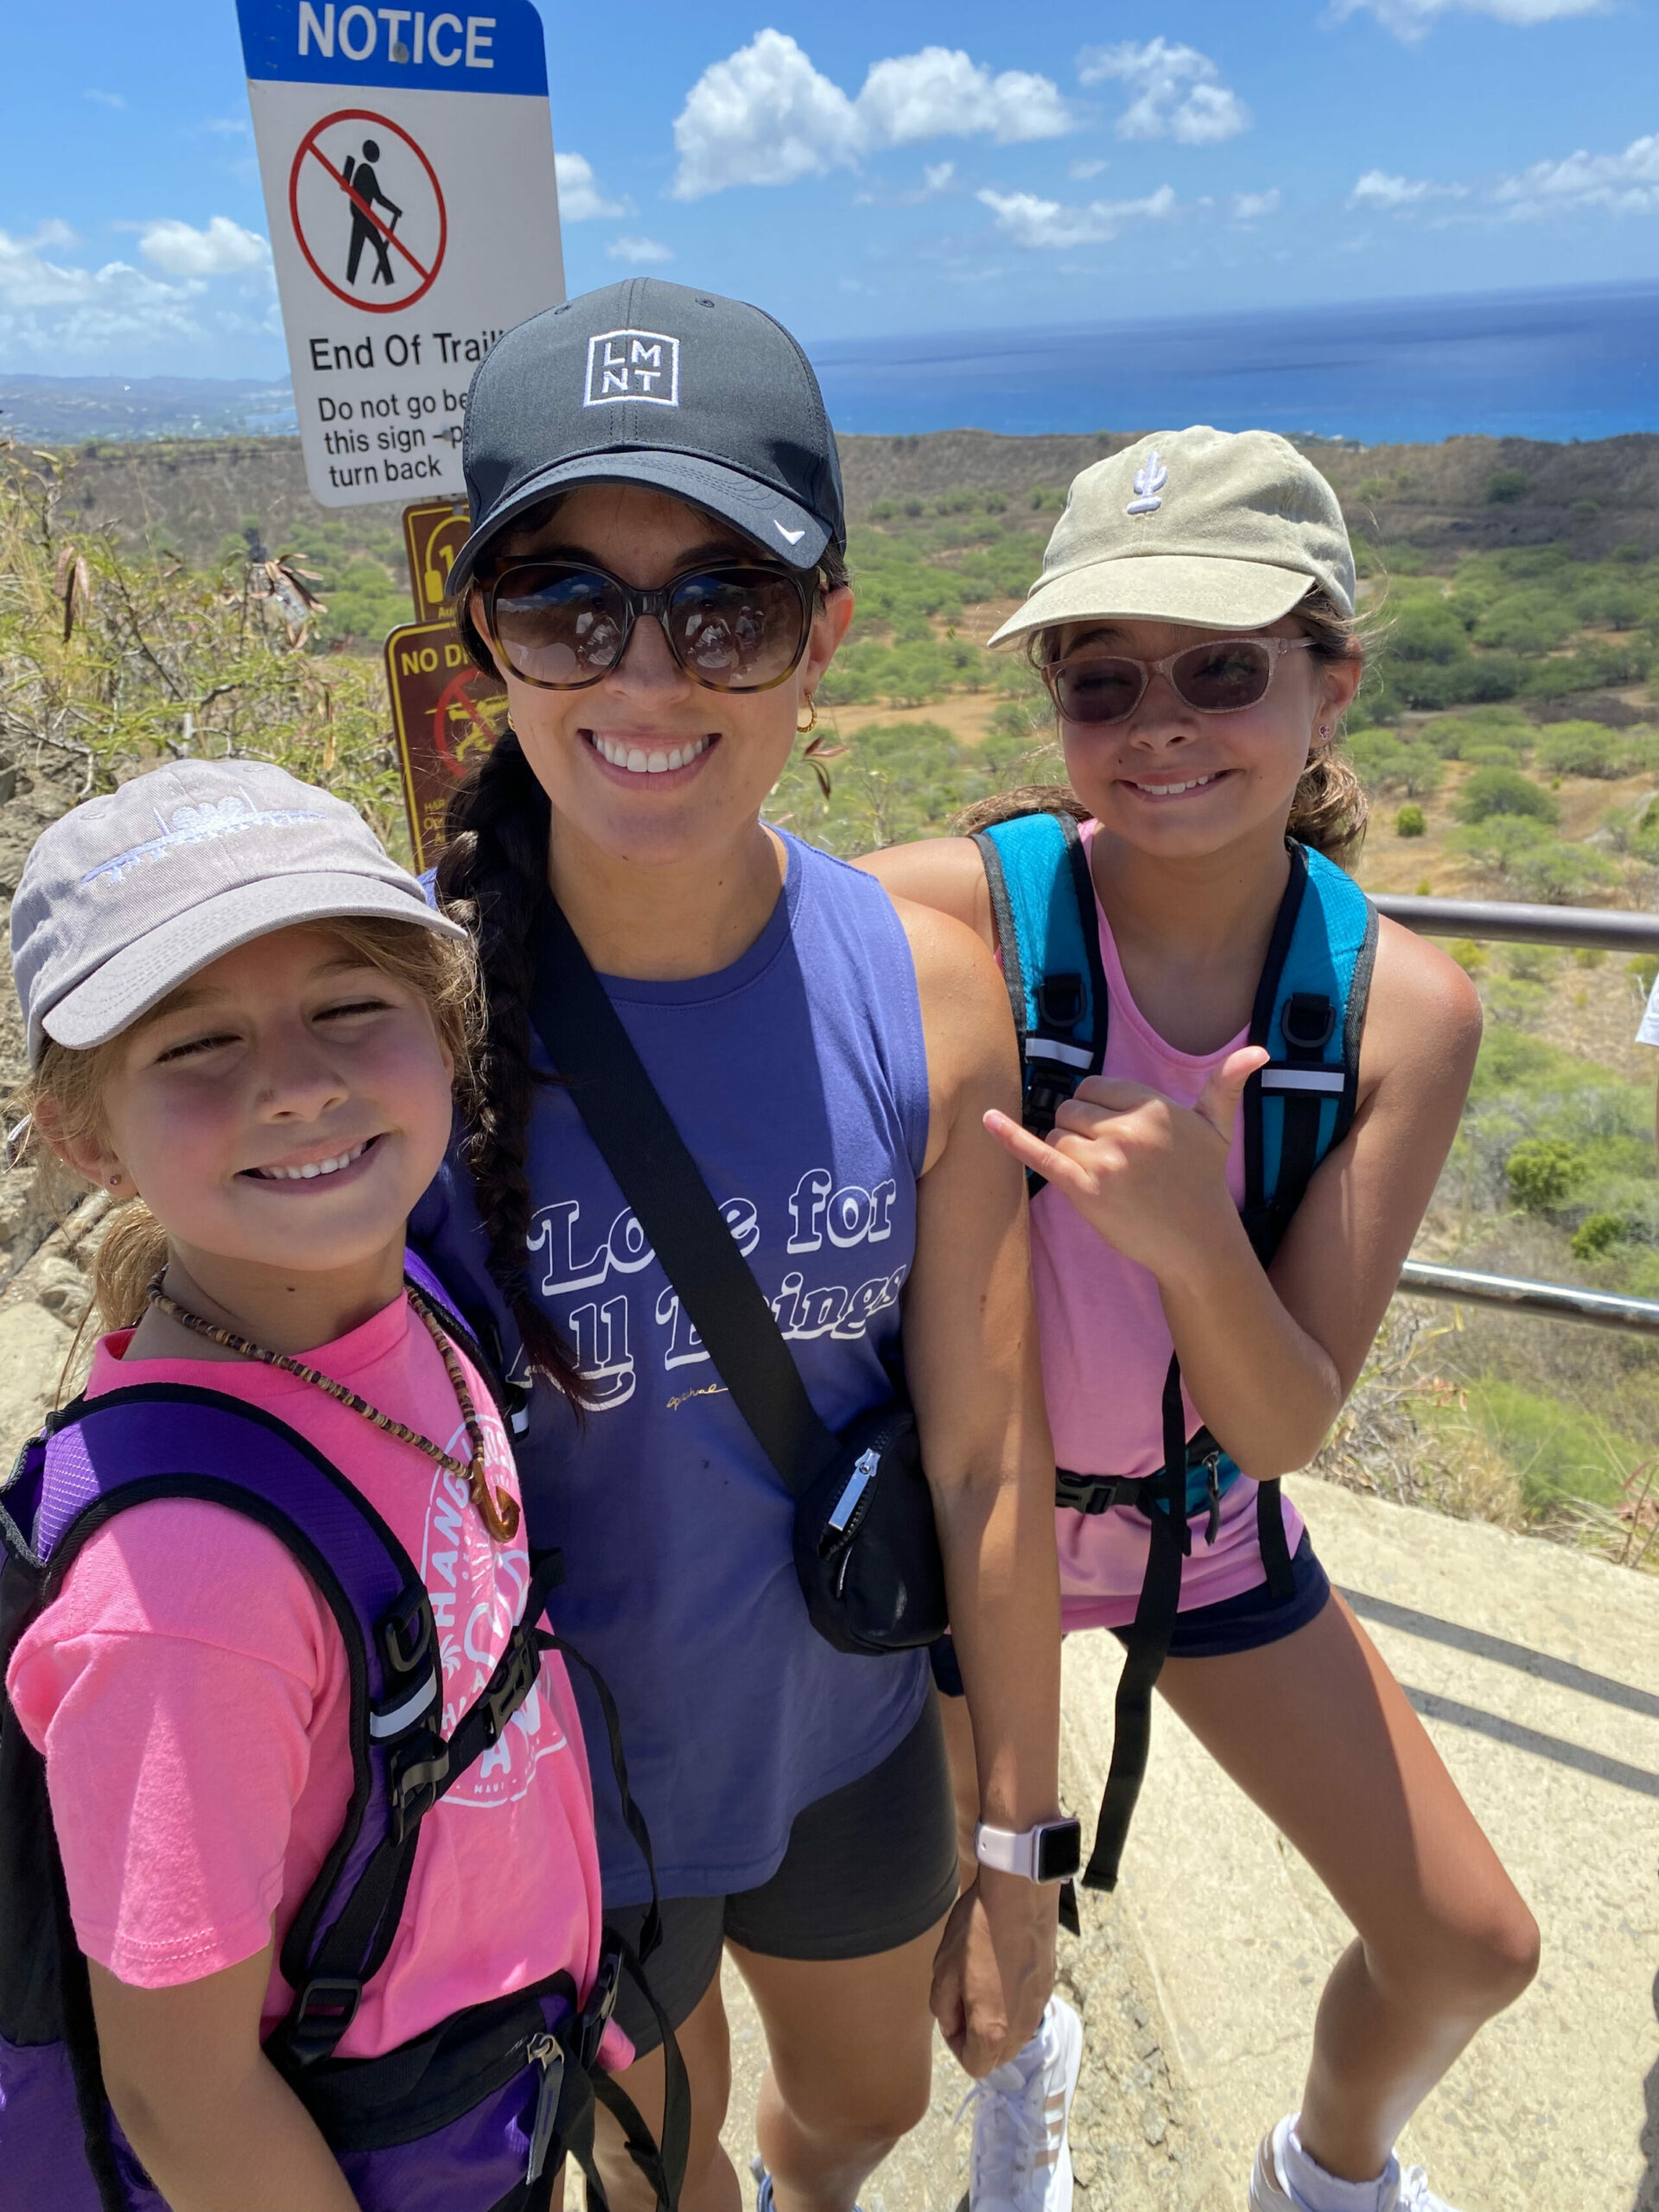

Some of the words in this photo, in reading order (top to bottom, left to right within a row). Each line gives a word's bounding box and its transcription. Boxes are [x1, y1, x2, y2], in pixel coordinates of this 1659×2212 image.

[297, 1, 497, 68] NOTICE
[308, 336, 375, 372] End
[385, 334, 421, 367] Of
[432, 330, 504, 364] Trai
[318, 397, 353, 423] Do
[360, 393, 400, 419] not
[407, 395, 436, 419] go
[324, 429, 370, 455] this
[377, 425, 425, 453] sign
[328, 465, 378, 487] turn
[384, 454, 442, 482] back
[400, 647, 438, 677] NO
[525, 1198, 760, 1297] Loe
[786, 1167, 896, 1255] for
[654, 1264, 906, 1371] ings
[474, 1781, 505, 1795] MAUI
